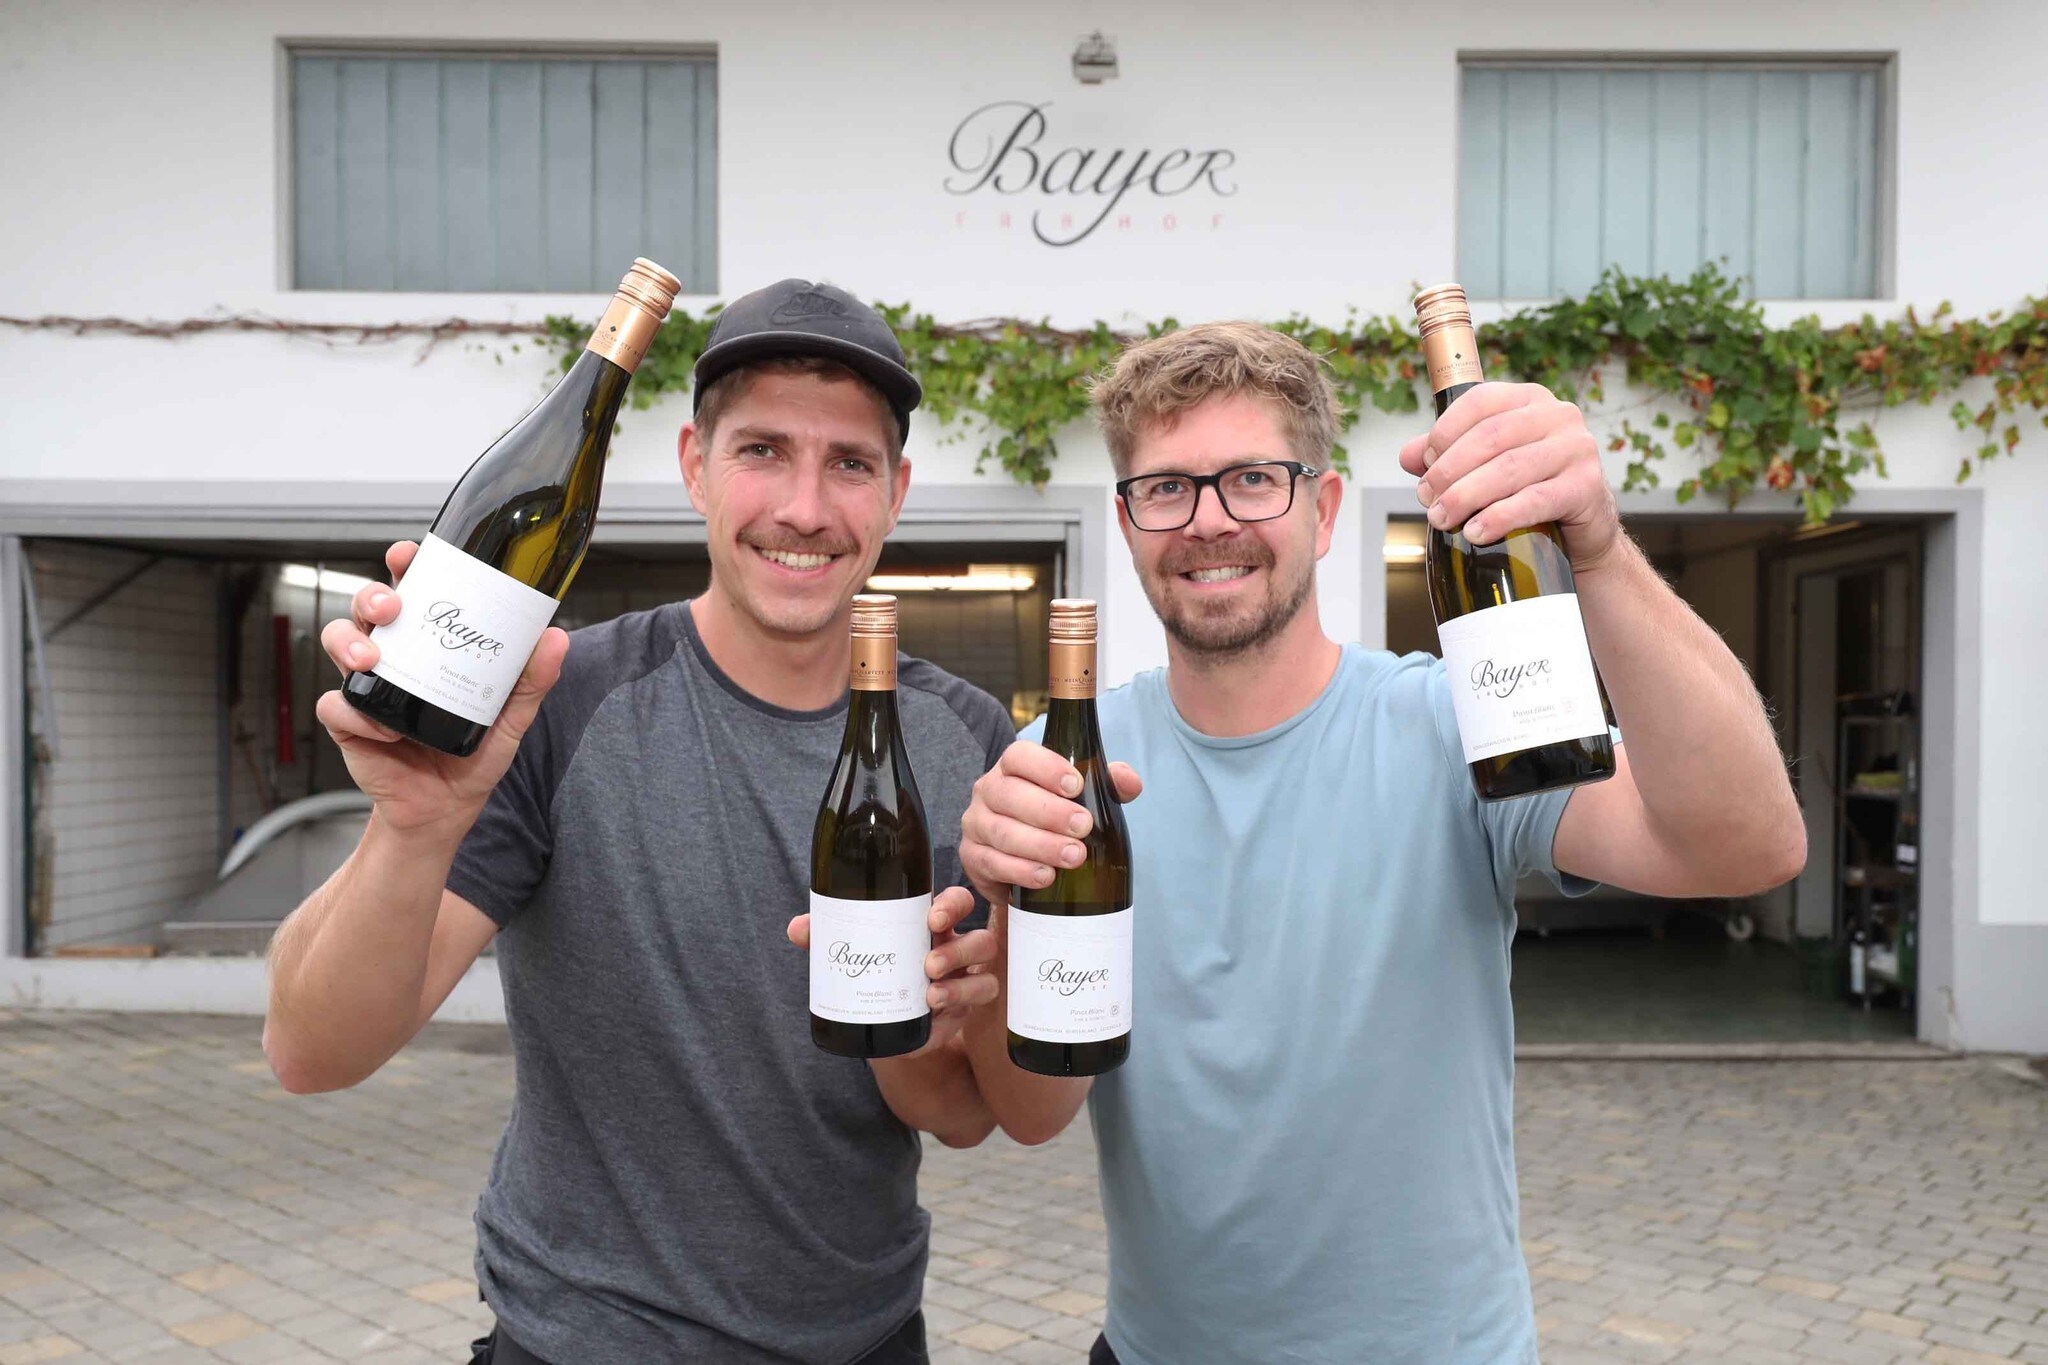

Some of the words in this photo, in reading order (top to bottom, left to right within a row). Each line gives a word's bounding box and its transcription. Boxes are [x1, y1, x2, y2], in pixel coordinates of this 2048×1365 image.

[943, 100, 1238, 247] Bayer
[423, 600, 505, 657] Bayer
[440, 664, 460, 679] Pinot
[460, 673, 480, 688] Blanc
[1470, 657, 1552, 699] Bayer
[827, 940, 896, 978] Bayer
[1037, 958, 1110, 997] Bayer
